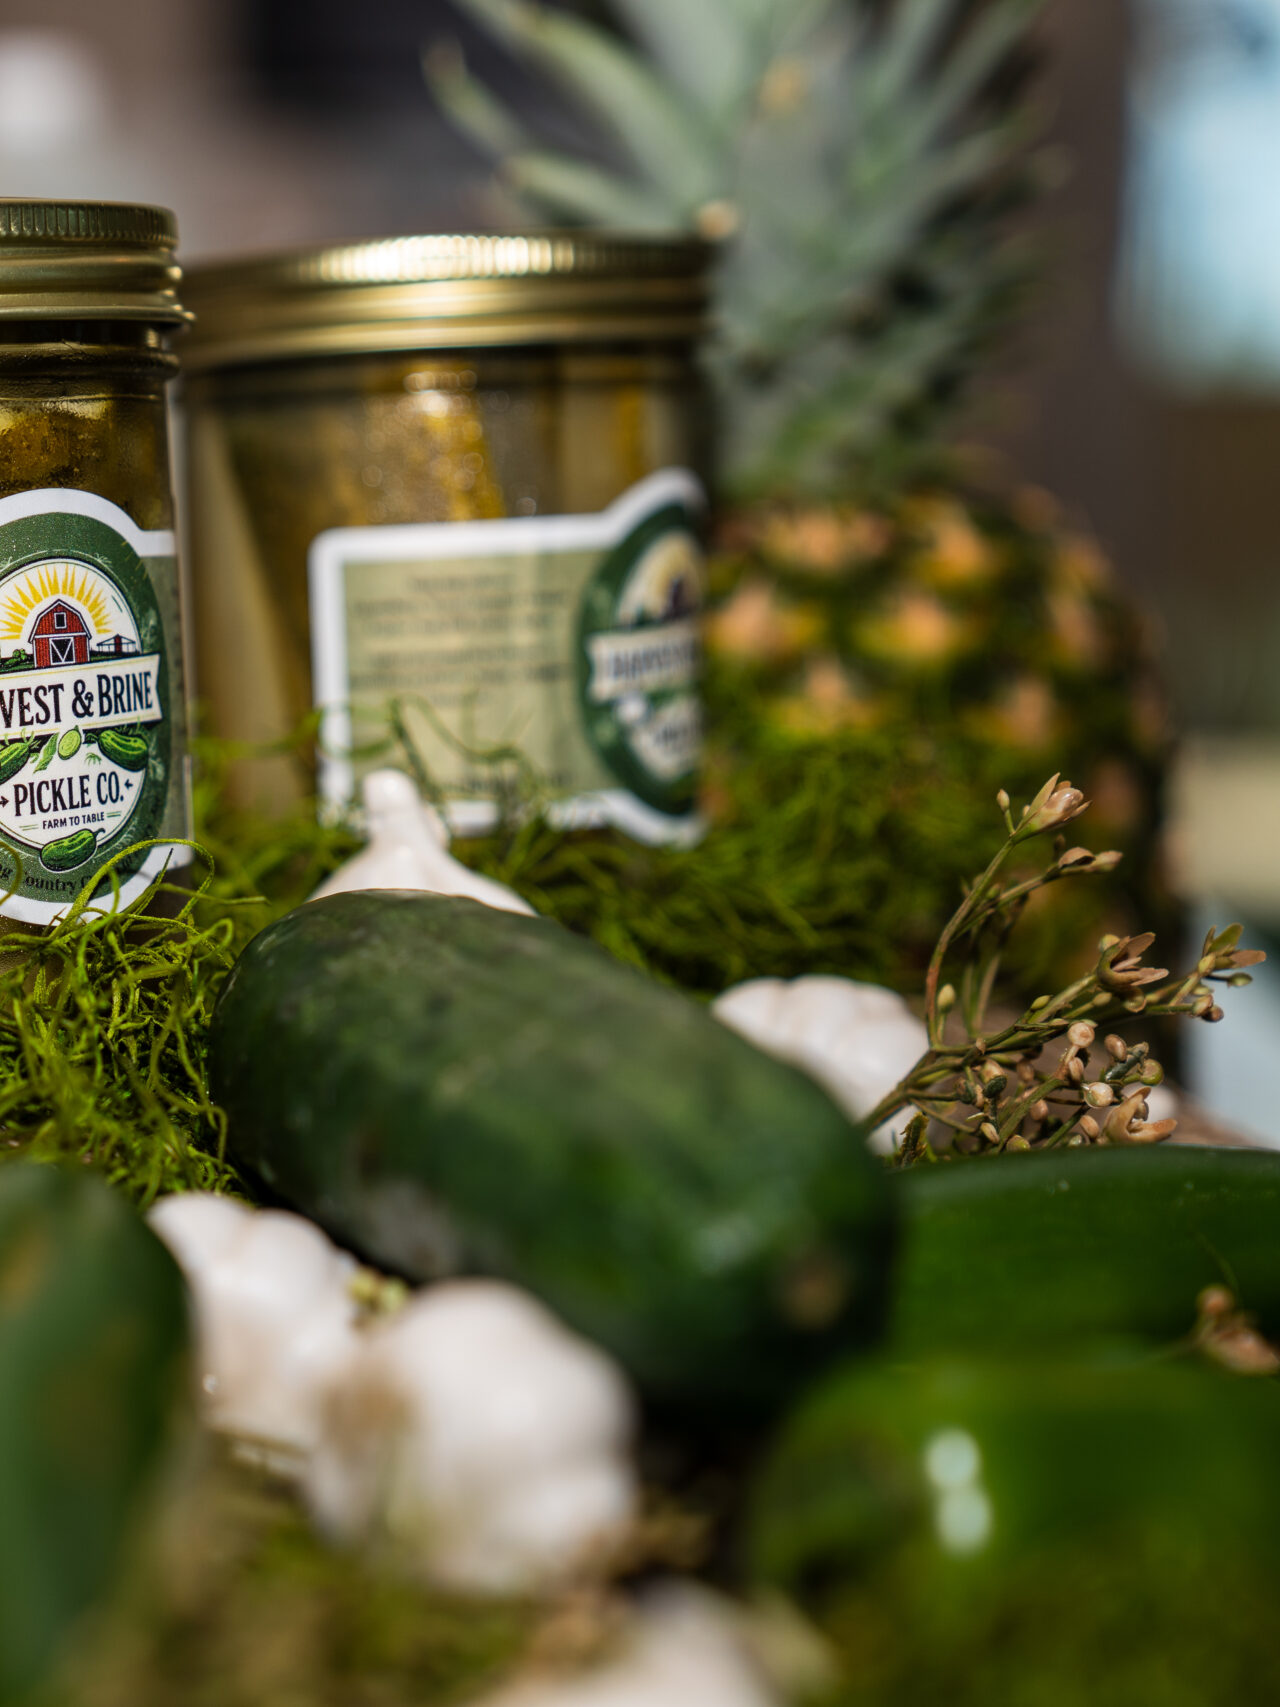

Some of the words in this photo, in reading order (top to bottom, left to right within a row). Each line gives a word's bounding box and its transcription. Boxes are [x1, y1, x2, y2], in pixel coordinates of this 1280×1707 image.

[71, 679, 96, 719] &
[13, 773, 93, 817] PICKLE
[96, 771, 124, 806] CO.
[42, 817, 68, 831] FARM
[68, 815, 81, 827] TO
[81, 811, 106, 825] TABLE
